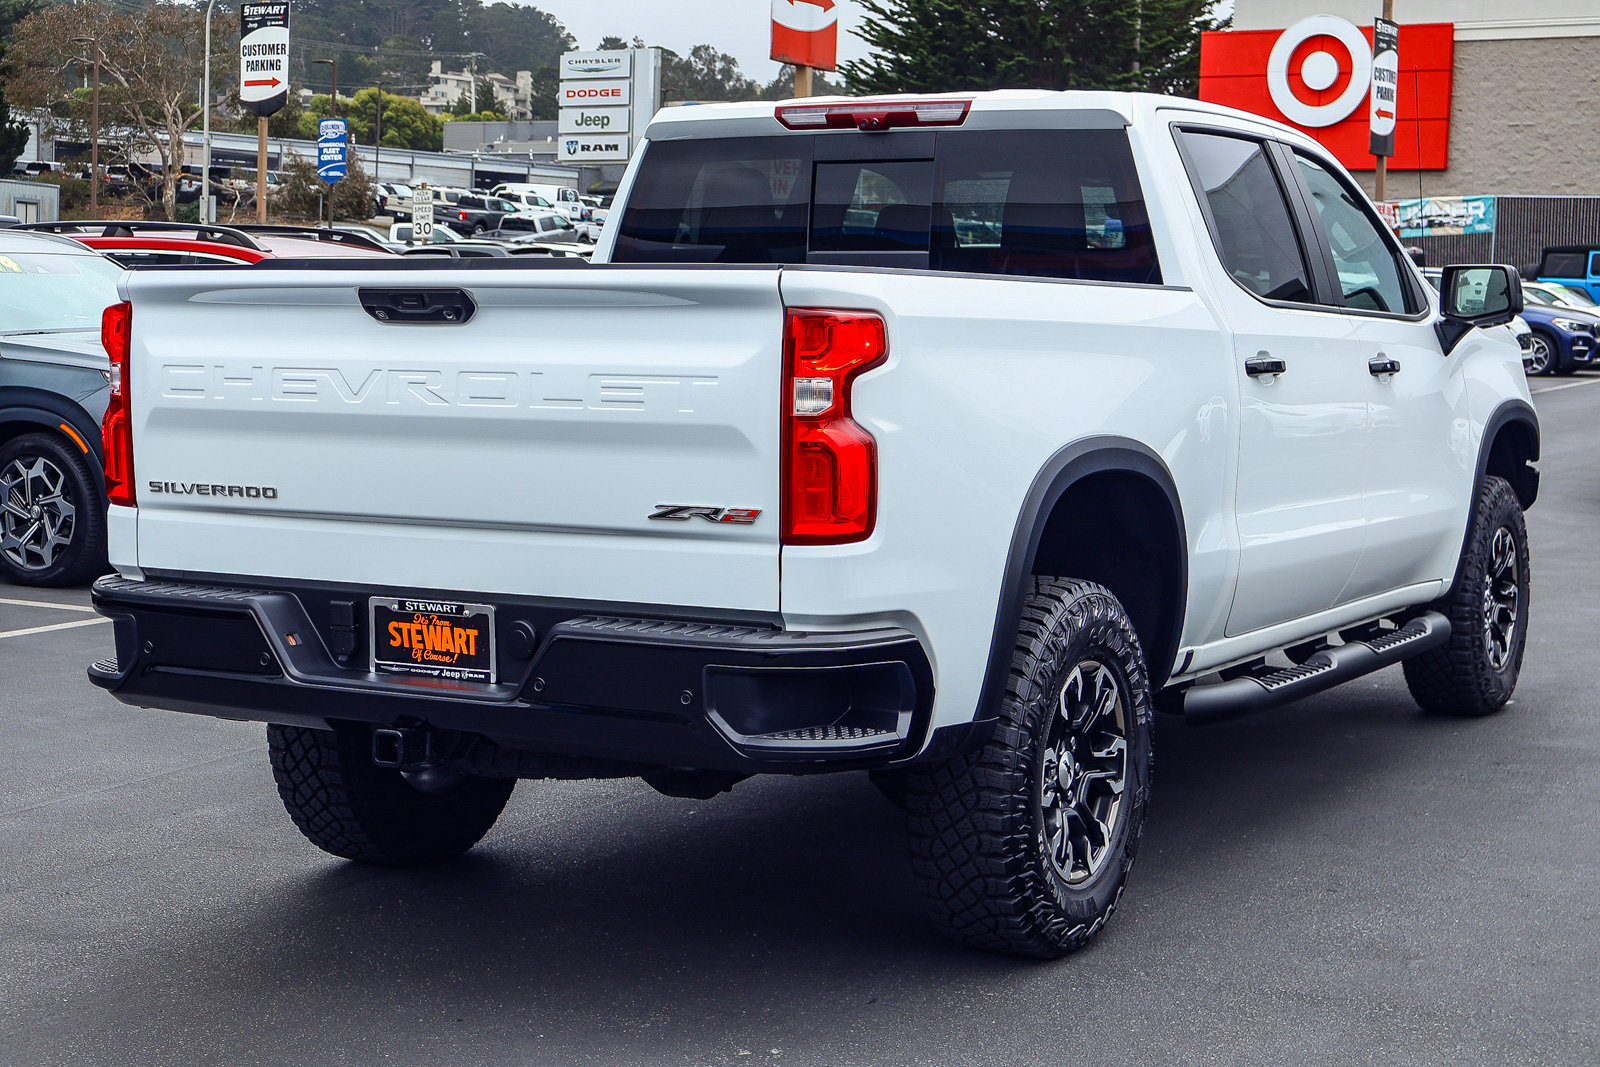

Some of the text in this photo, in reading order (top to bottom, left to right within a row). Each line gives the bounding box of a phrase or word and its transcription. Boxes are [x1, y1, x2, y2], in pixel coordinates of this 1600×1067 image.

[243, 4, 287, 16] STEWART
[242, 43, 287, 57] CUSTOMER
[246, 59, 281, 72] PARKING
[566, 88, 621, 98] DODGE
[575, 112, 610, 129] Jeep
[580, 143, 619, 152] RAM
[414, 222, 432, 235] 30
[161, 364, 720, 414] CHEVROLET
[148, 481, 278, 499] SILVERADO
[647, 503, 763, 525] ZR2
[405, 601, 458, 614] STEWART
[430, 615, 452, 627] From
[387, 621, 479, 656] STEWART
[411, 648, 422, 662] Of
[441, 669, 460, 679] Jeep
